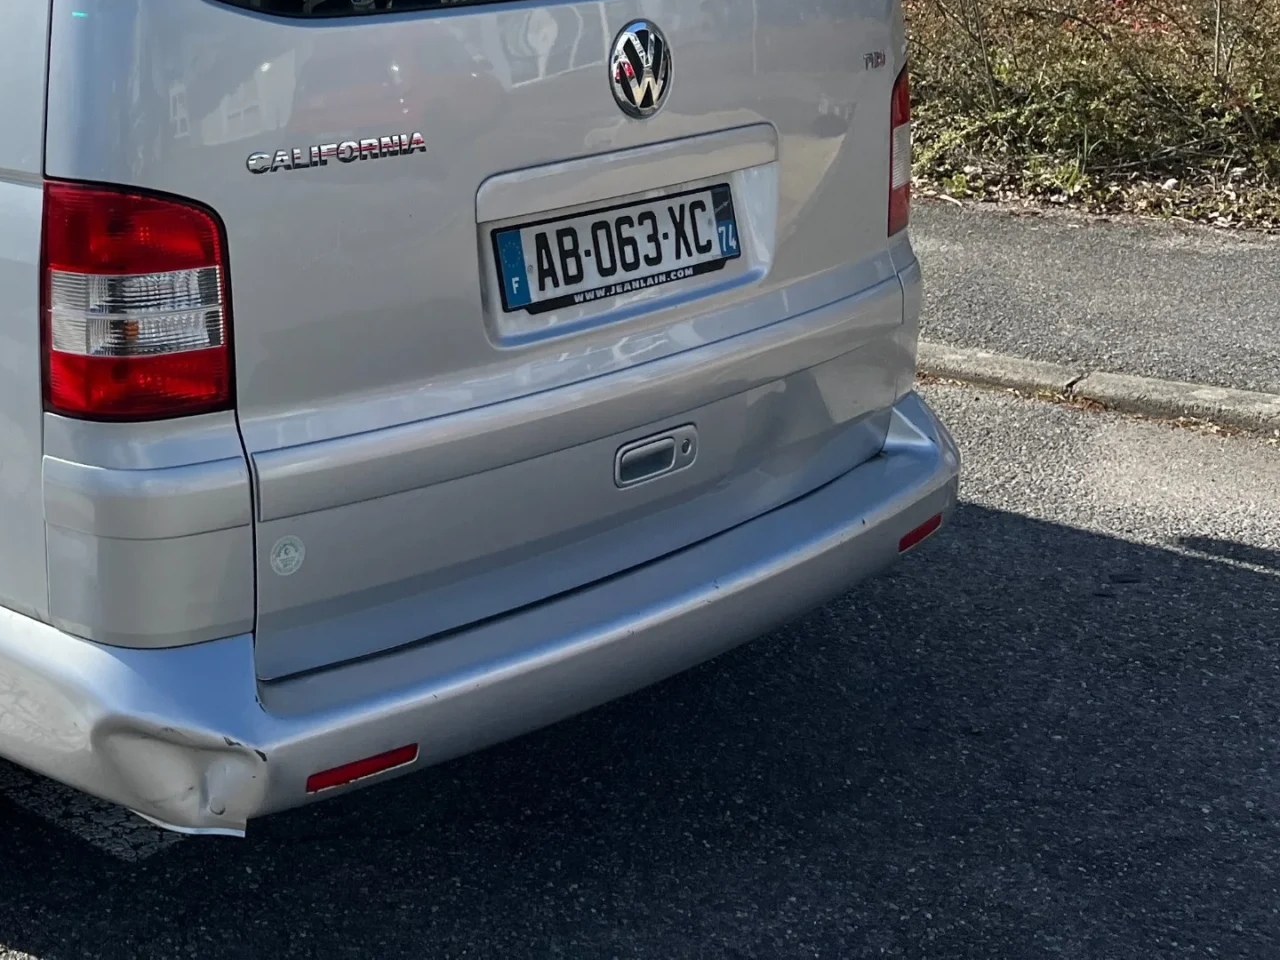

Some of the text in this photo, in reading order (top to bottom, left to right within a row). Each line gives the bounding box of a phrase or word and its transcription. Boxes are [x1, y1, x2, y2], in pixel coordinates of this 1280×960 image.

[245, 132, 427, 174] CALIFORNIA
[718, 223, 738, 253] 74
[511, 276, 520, 295] F
[573, 266, 695, 304] WWW.JEANLAIN.COM
